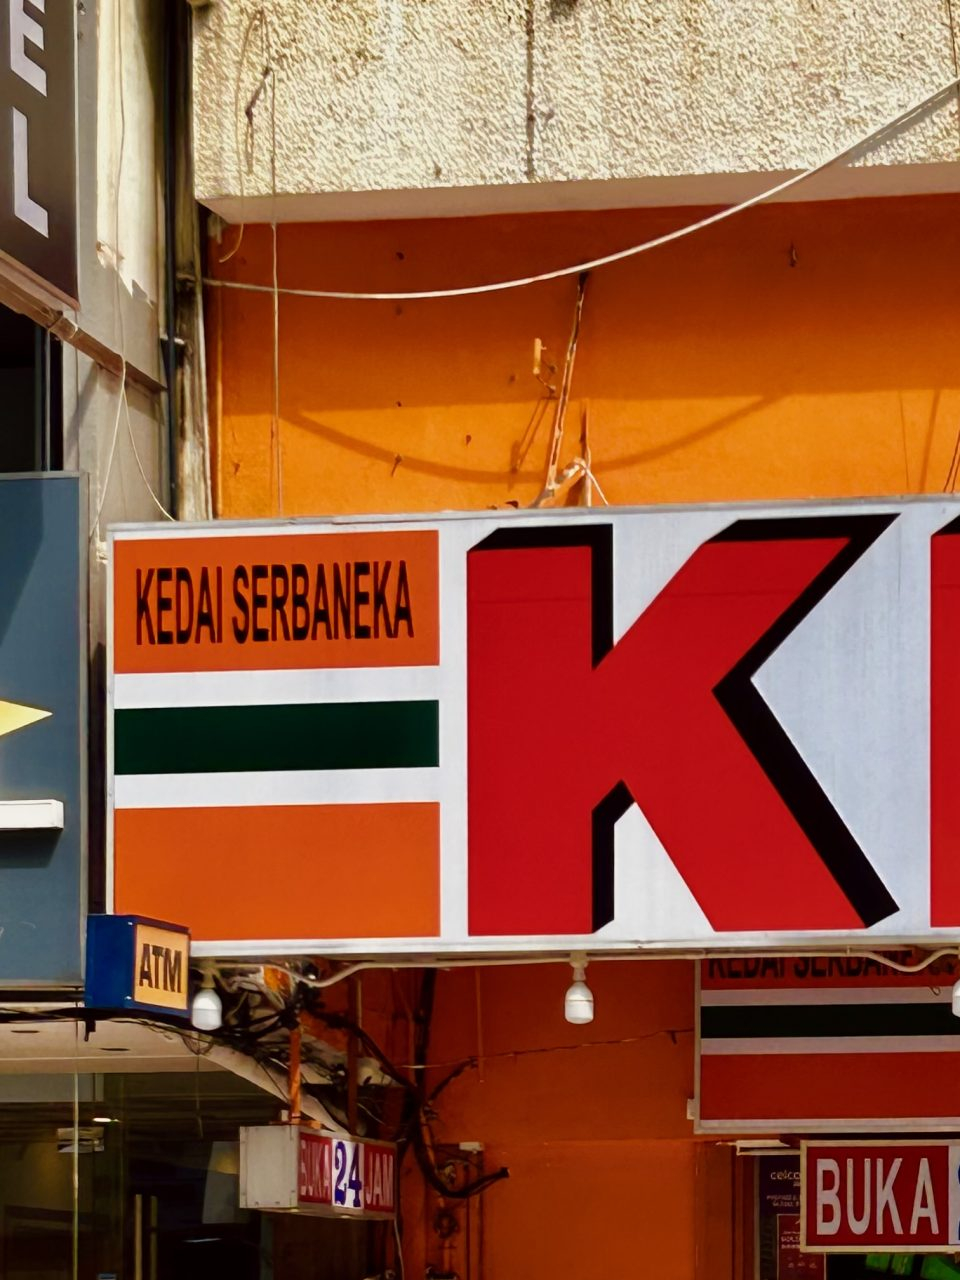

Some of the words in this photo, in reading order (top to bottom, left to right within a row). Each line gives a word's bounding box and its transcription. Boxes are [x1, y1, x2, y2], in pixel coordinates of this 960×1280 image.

[135, 565, 224, 646] KEDAI
[231, 559, 415, 645] SERBANEKA
[138, 943, 182, 993] ATM
[334, 1141, 362, 1208] 24
[365, 1151, 395, 1209] JAM
[815, 1156, 940, 1236] BUKA
